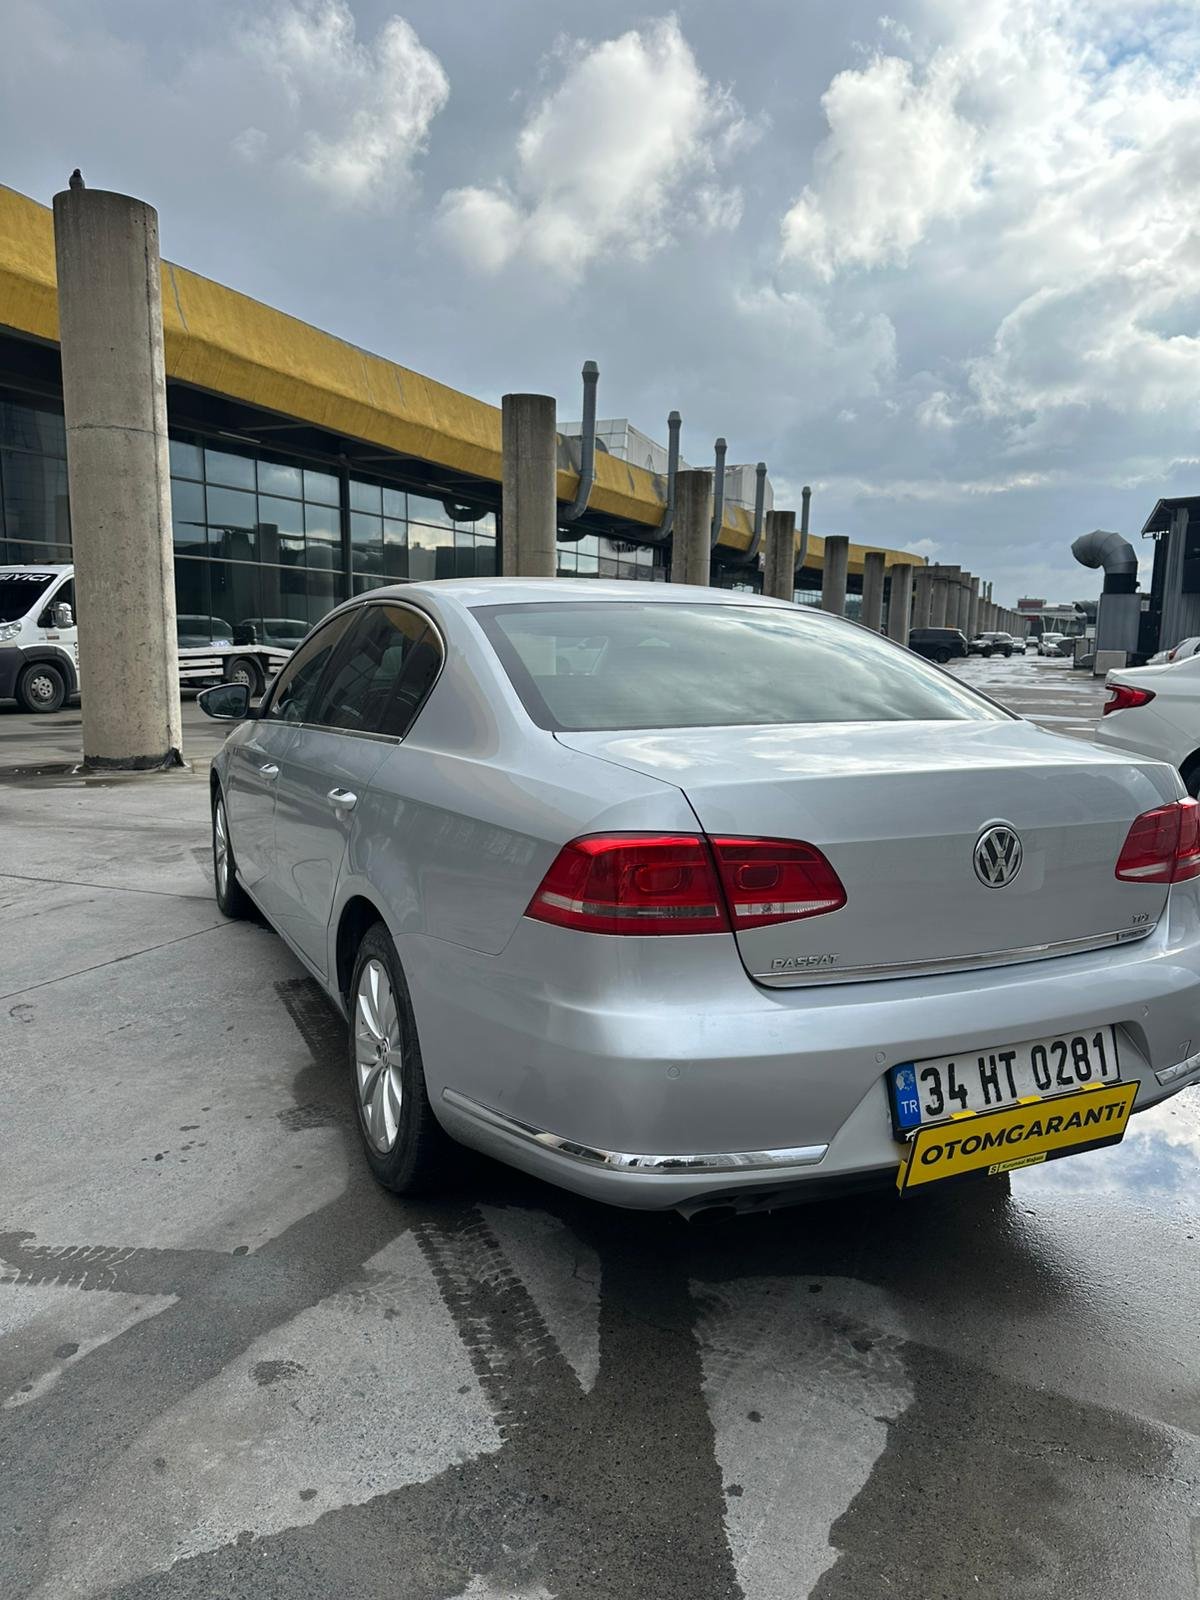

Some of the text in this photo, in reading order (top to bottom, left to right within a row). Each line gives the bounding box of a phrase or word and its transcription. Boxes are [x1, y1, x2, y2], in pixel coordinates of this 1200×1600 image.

[771, 953, 840, 969] PASSAT
[920, 1032, 1108, 1116] 34 HT 0281
[901, 1100, 919, 1115] TR
